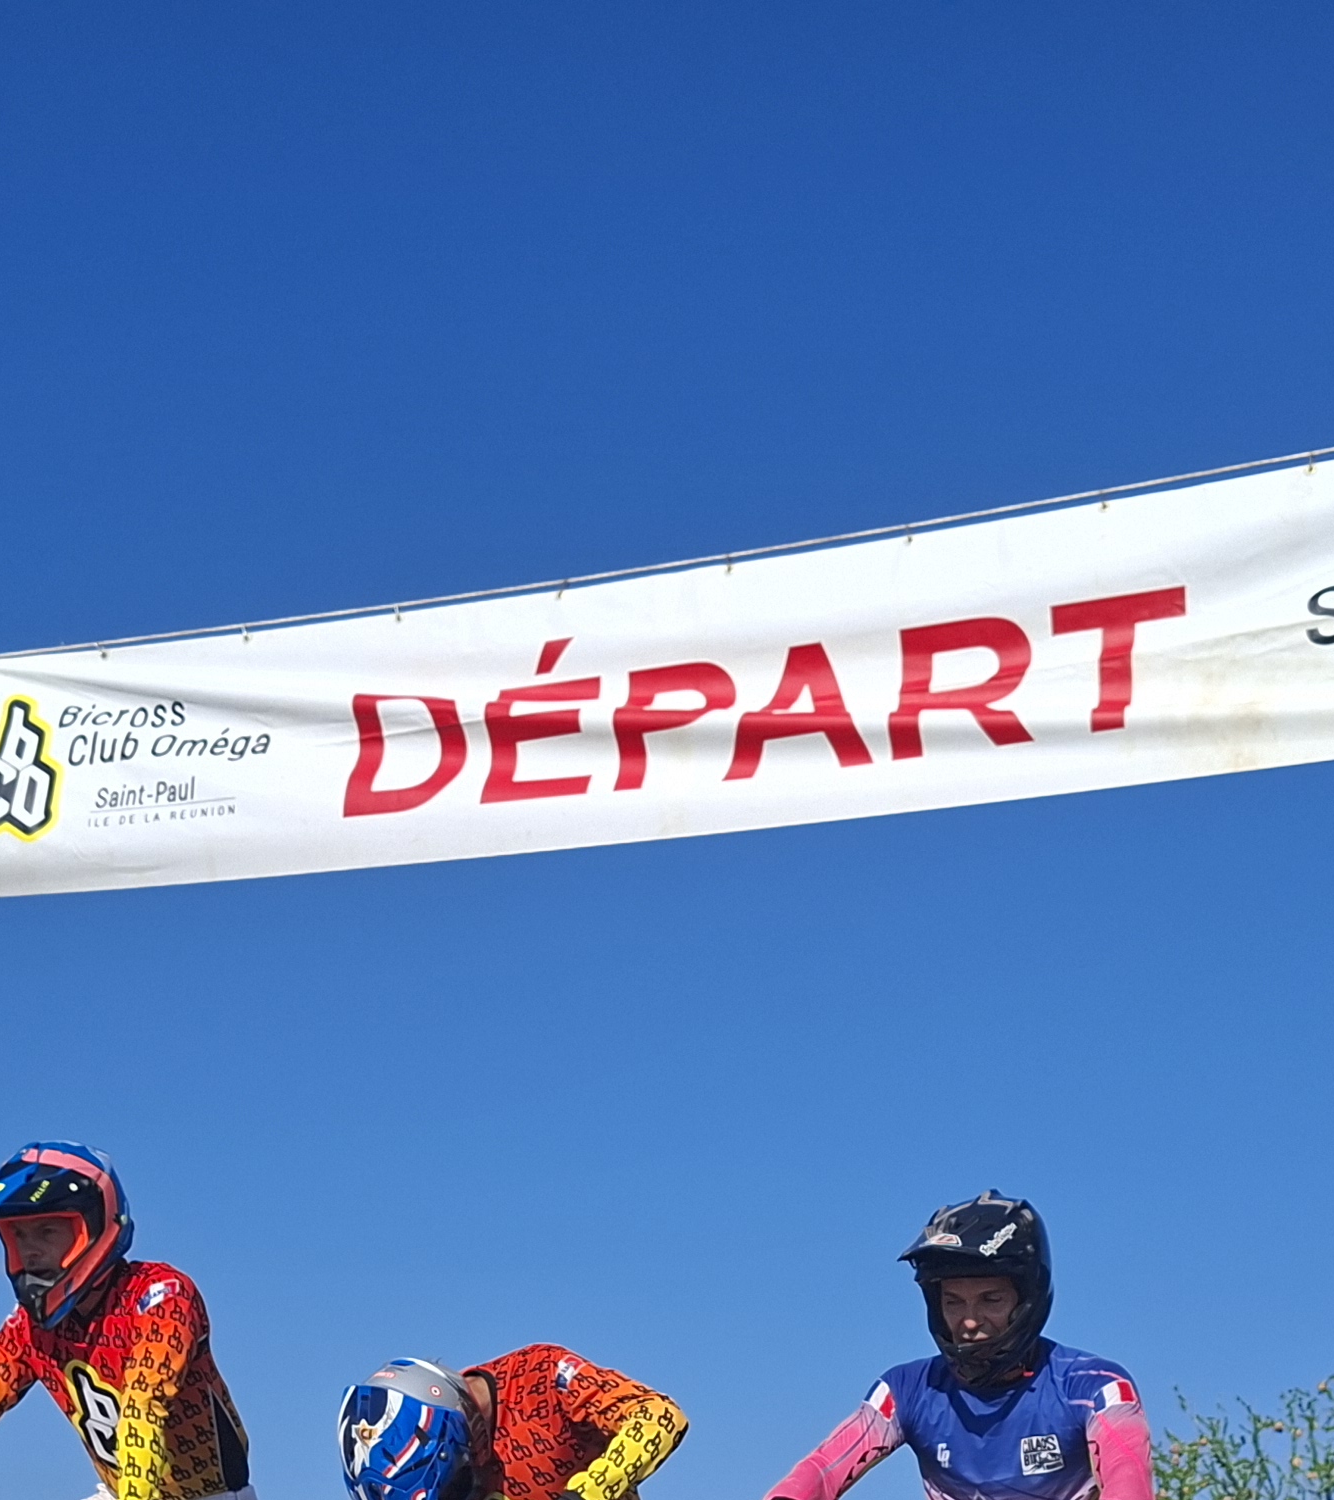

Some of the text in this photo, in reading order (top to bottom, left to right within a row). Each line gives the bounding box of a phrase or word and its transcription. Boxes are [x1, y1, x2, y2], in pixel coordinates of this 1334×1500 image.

[58, 700, 186, 729] Bicross
[343, 586, 1187, 818] DÉPART
[68, 727, 271, 766] Club Oméga
[94, 776, 195, 810] Saint-Paul
[119, 813, 135, 826] DE
[144, 811, 161, 824] LA
